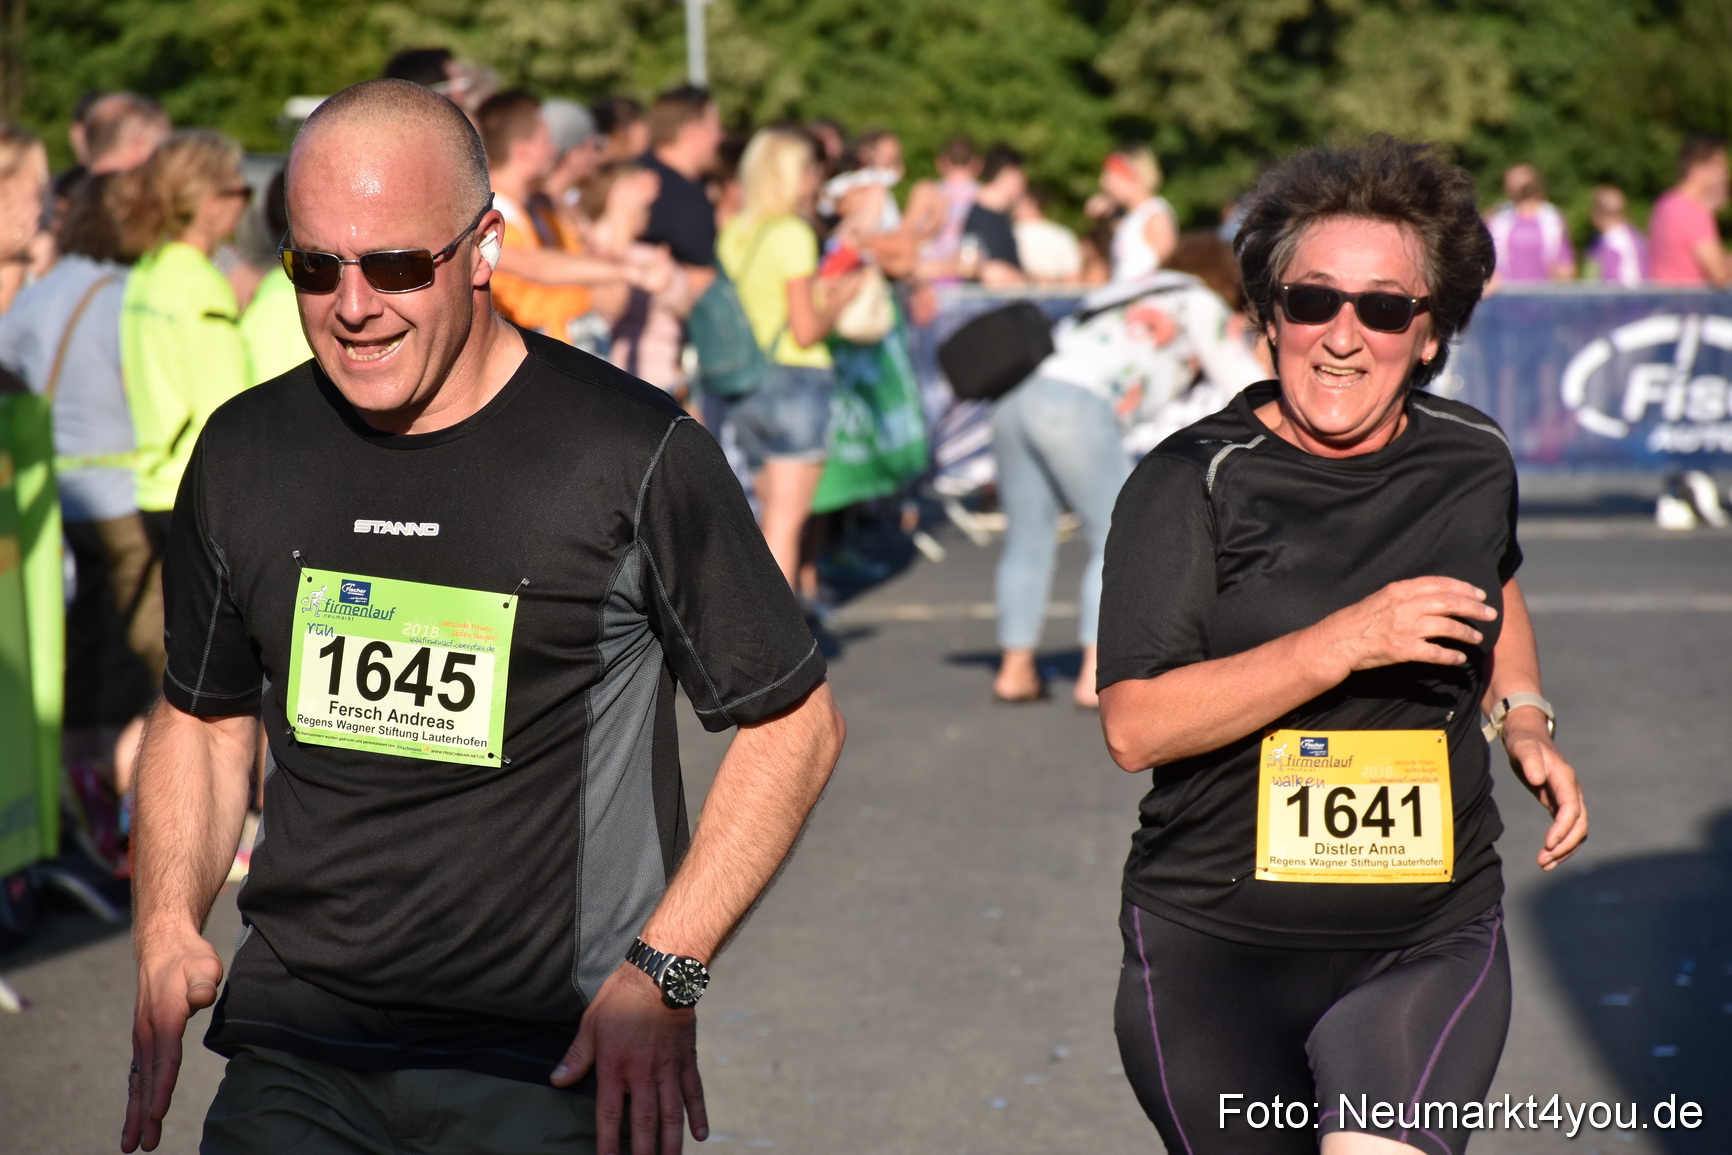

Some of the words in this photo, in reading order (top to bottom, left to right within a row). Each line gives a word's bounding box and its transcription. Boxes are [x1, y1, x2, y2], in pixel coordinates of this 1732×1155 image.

[1622, 362, 1732, 424] Fis
[354, 519, 440, 536] STANNO
[323, 613, 355, 621] neumarkt
[324, 598, 396, 620] firmenlauf
[402, 622, 439, 639] 2018
[319, 635, 477, 712] 1645
[329, 700, 382, 721] Fersch
[387, 708, 455, 730] Andreas
[297, 713, 333, 727] Regens
[336, 719, 376, 733] Wagner
[378, 725, 419, 741] Stiftung
[422, 731, 487, 747] Lauterhofen
[1287, 754, 1354, 768] firmenlauf
[1272, 774, 1325, 788] walken
[1287, 785, 1422, 839] 1641
[1315, 843, 1364, 855] Distler
[1369, 843, 1405, 855] Anna
[1269, 856, 1306, 867] Regens
[1309, 858, 1347, 868] Wagner
[1350, 858, 1389, 869] Stiftung
[1391, 858, 1444, 867] Lauterhofen
